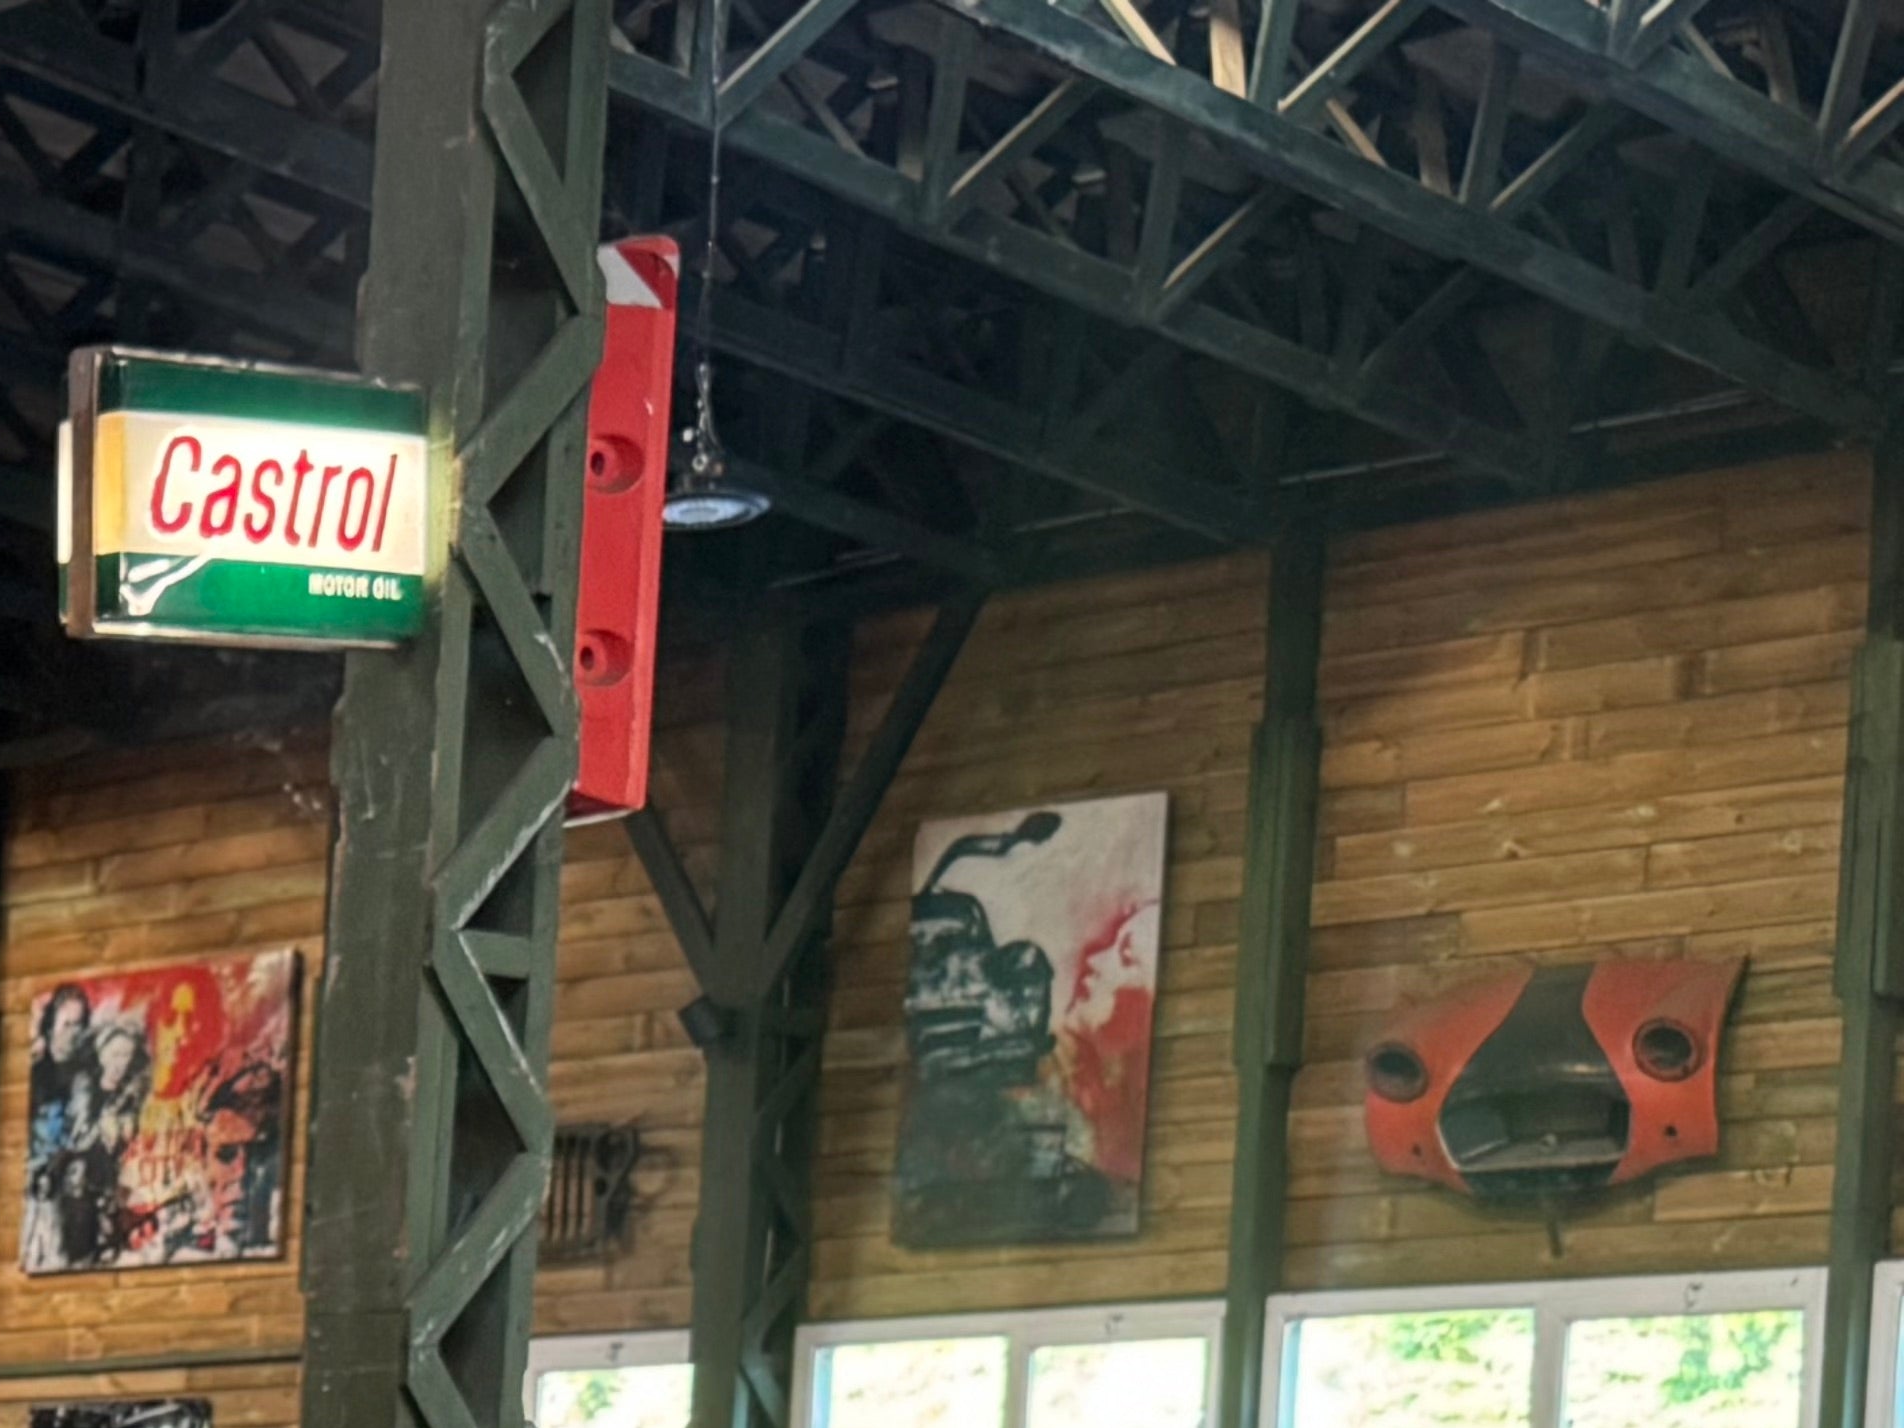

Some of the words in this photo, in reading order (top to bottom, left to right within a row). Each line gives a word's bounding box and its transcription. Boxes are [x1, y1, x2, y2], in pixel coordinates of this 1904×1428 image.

[148, 435, 398, 553] Castrol
[308, 573, 370, 599] MOTOR
[372, 576, 403, 601] OIL
